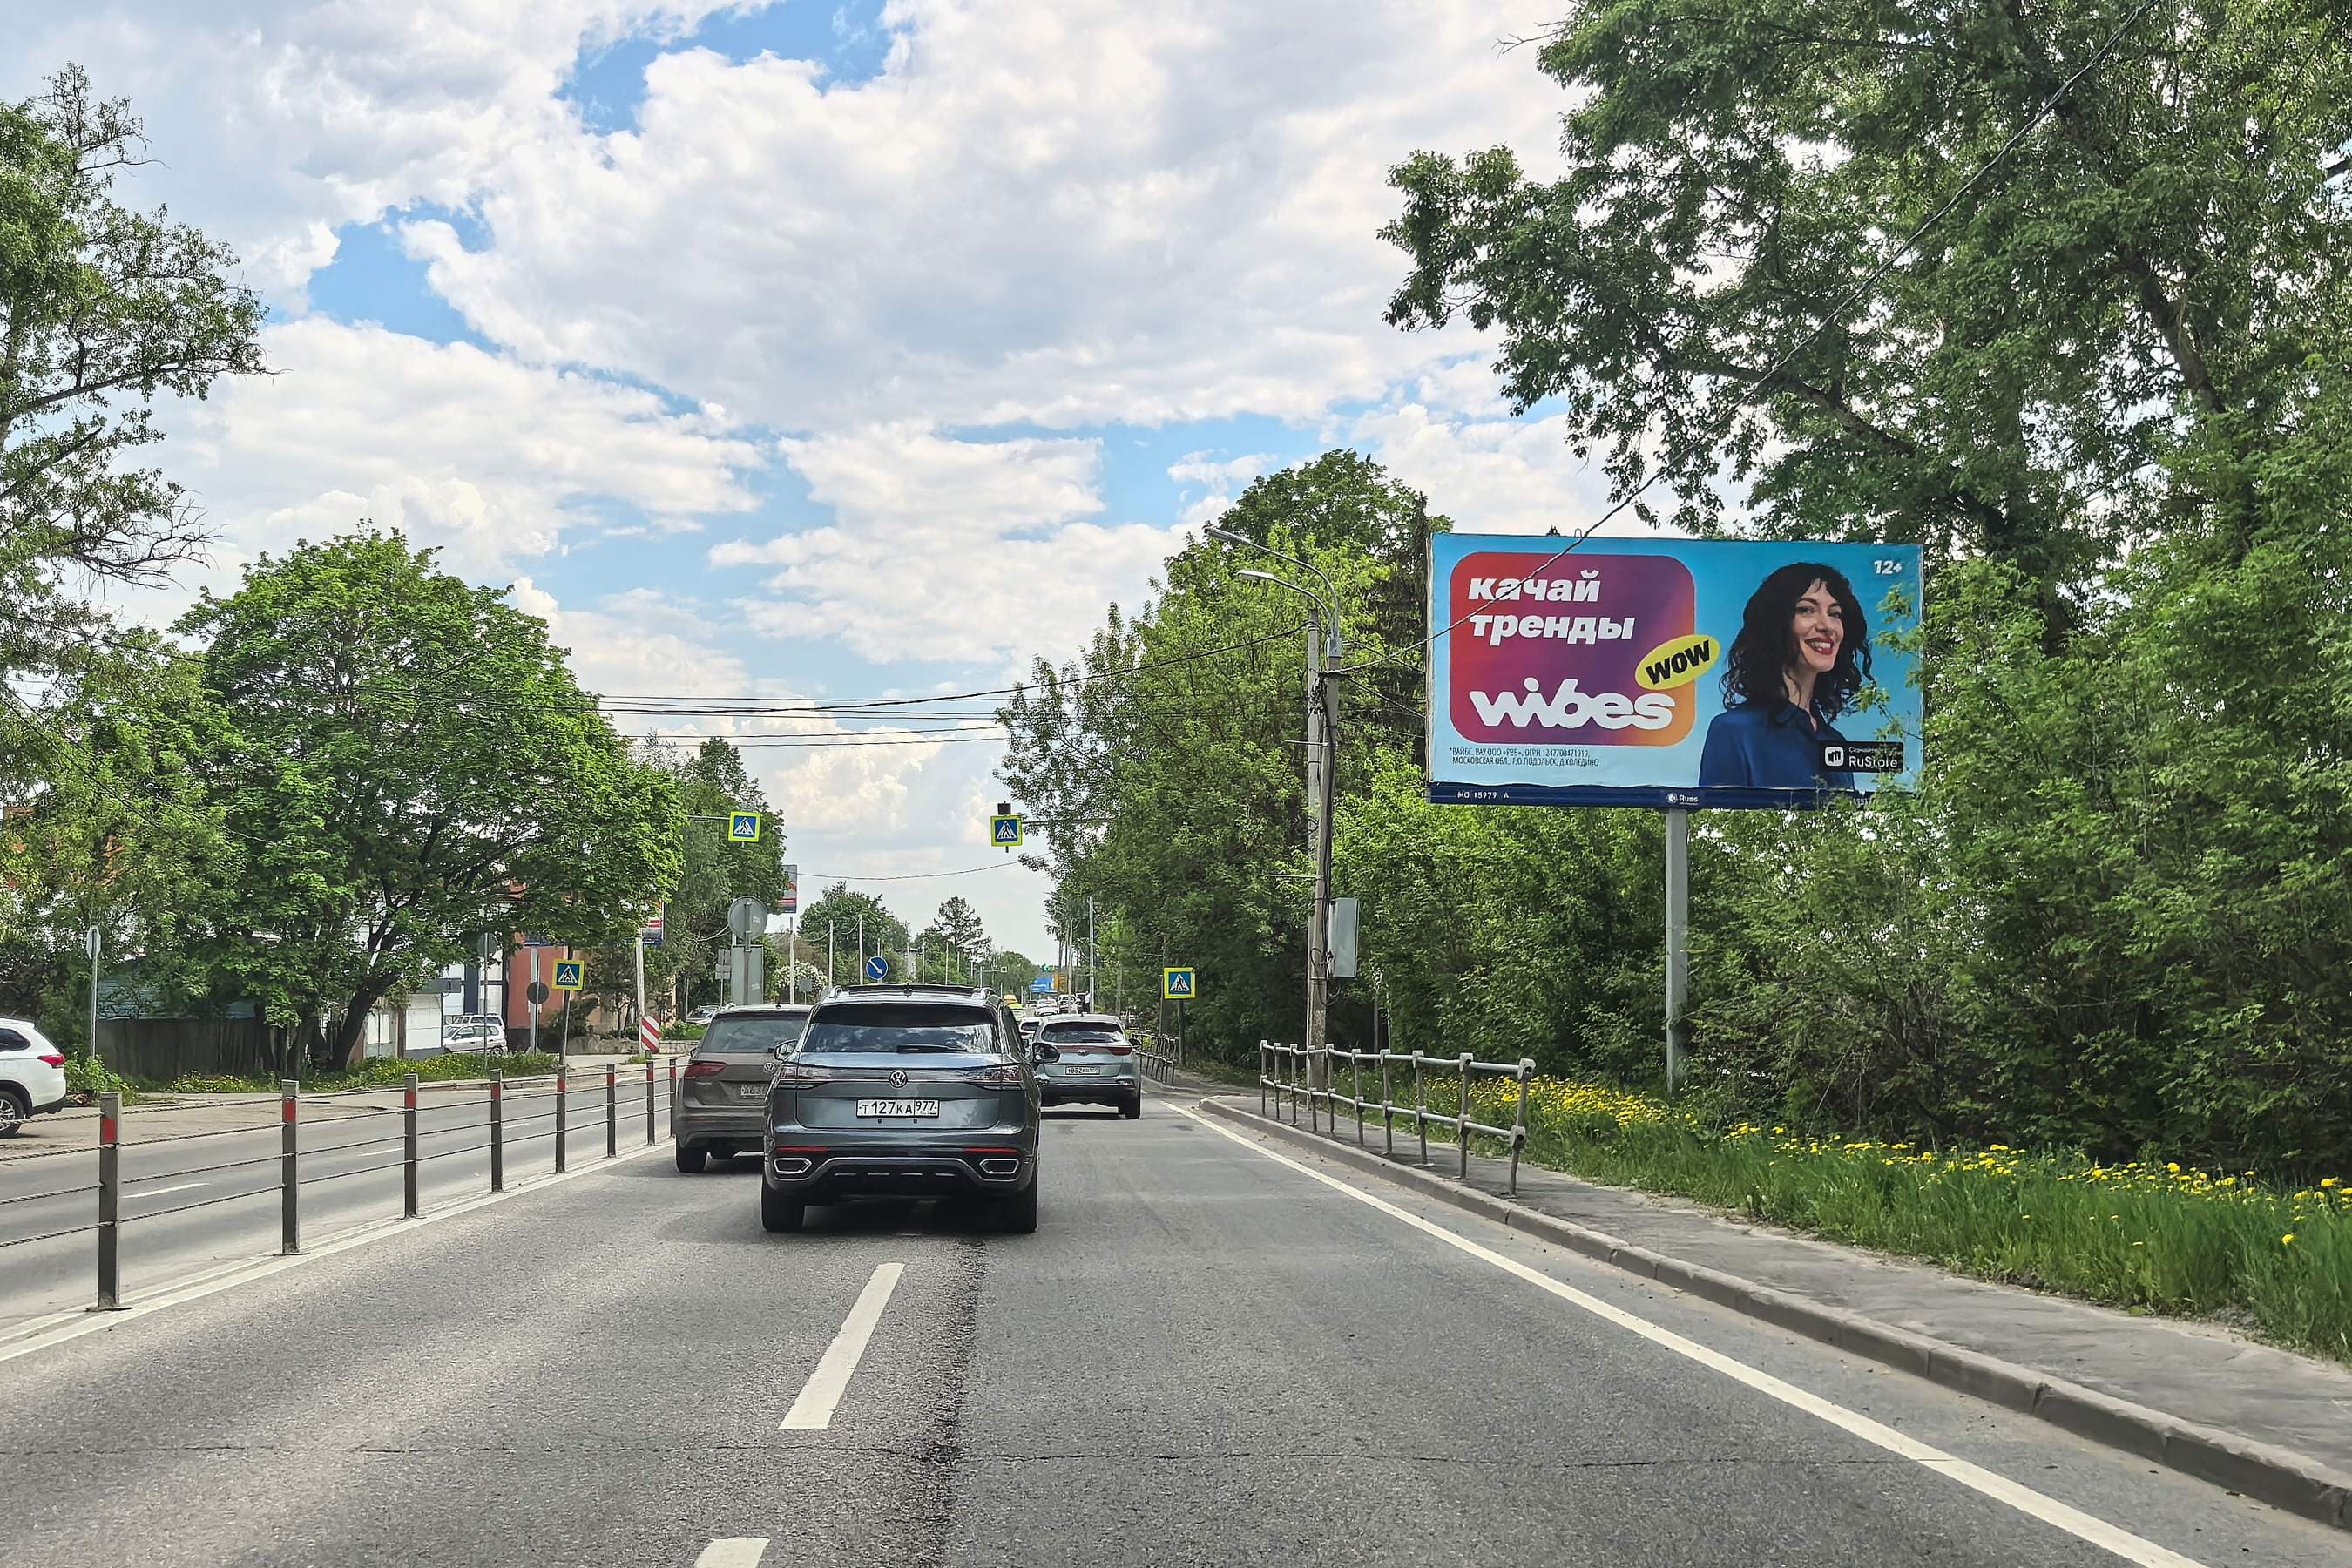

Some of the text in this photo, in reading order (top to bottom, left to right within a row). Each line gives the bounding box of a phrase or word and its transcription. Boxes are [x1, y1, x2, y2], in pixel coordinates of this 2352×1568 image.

[1874, 560, 1903, 575] 12+
[1468, 569, 1600, 602] качай
[1470, 614, 1636, 646] тренды
[1469, 677, 1676, 730] wibes
[1487, 747, 1501, 756] ООО
[1524, 748, 1541, 757] ОГРН
[1452, 756, 1494, 765] МОСКОВСКАЯ
[916, 1100, 936, 1111] 977
